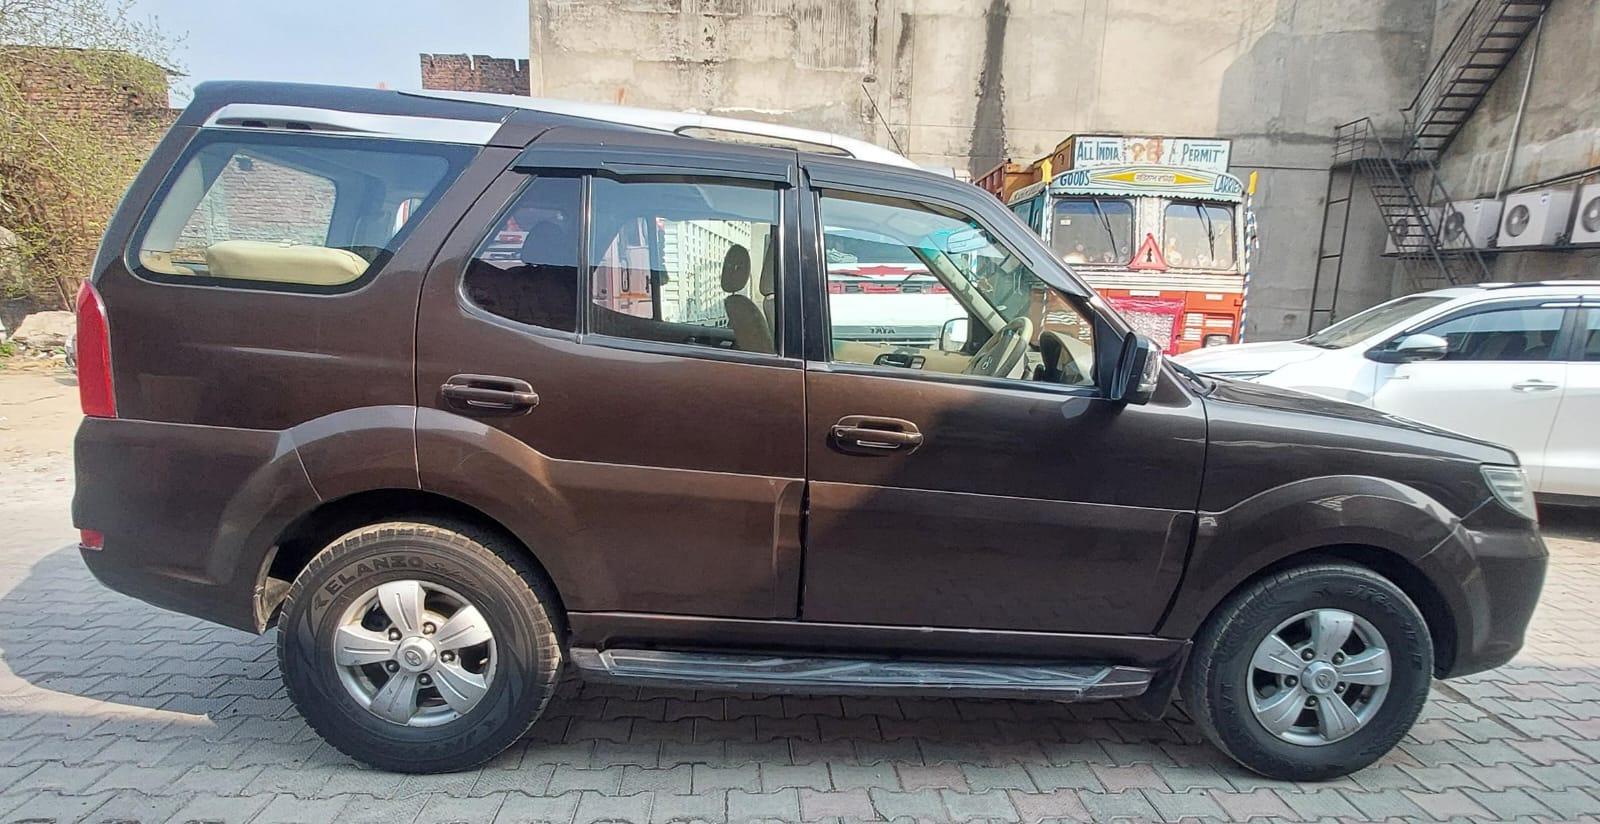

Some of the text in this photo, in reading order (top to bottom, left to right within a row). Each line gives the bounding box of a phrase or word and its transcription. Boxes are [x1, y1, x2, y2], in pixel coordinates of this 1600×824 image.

[1077, 141, 1094, 161] ALL
[1096, 141, 1121, 162] INDIA
[1183, 143, 1220, 163] PERMIT
[1060, 170, 1091, 187] GOODS
